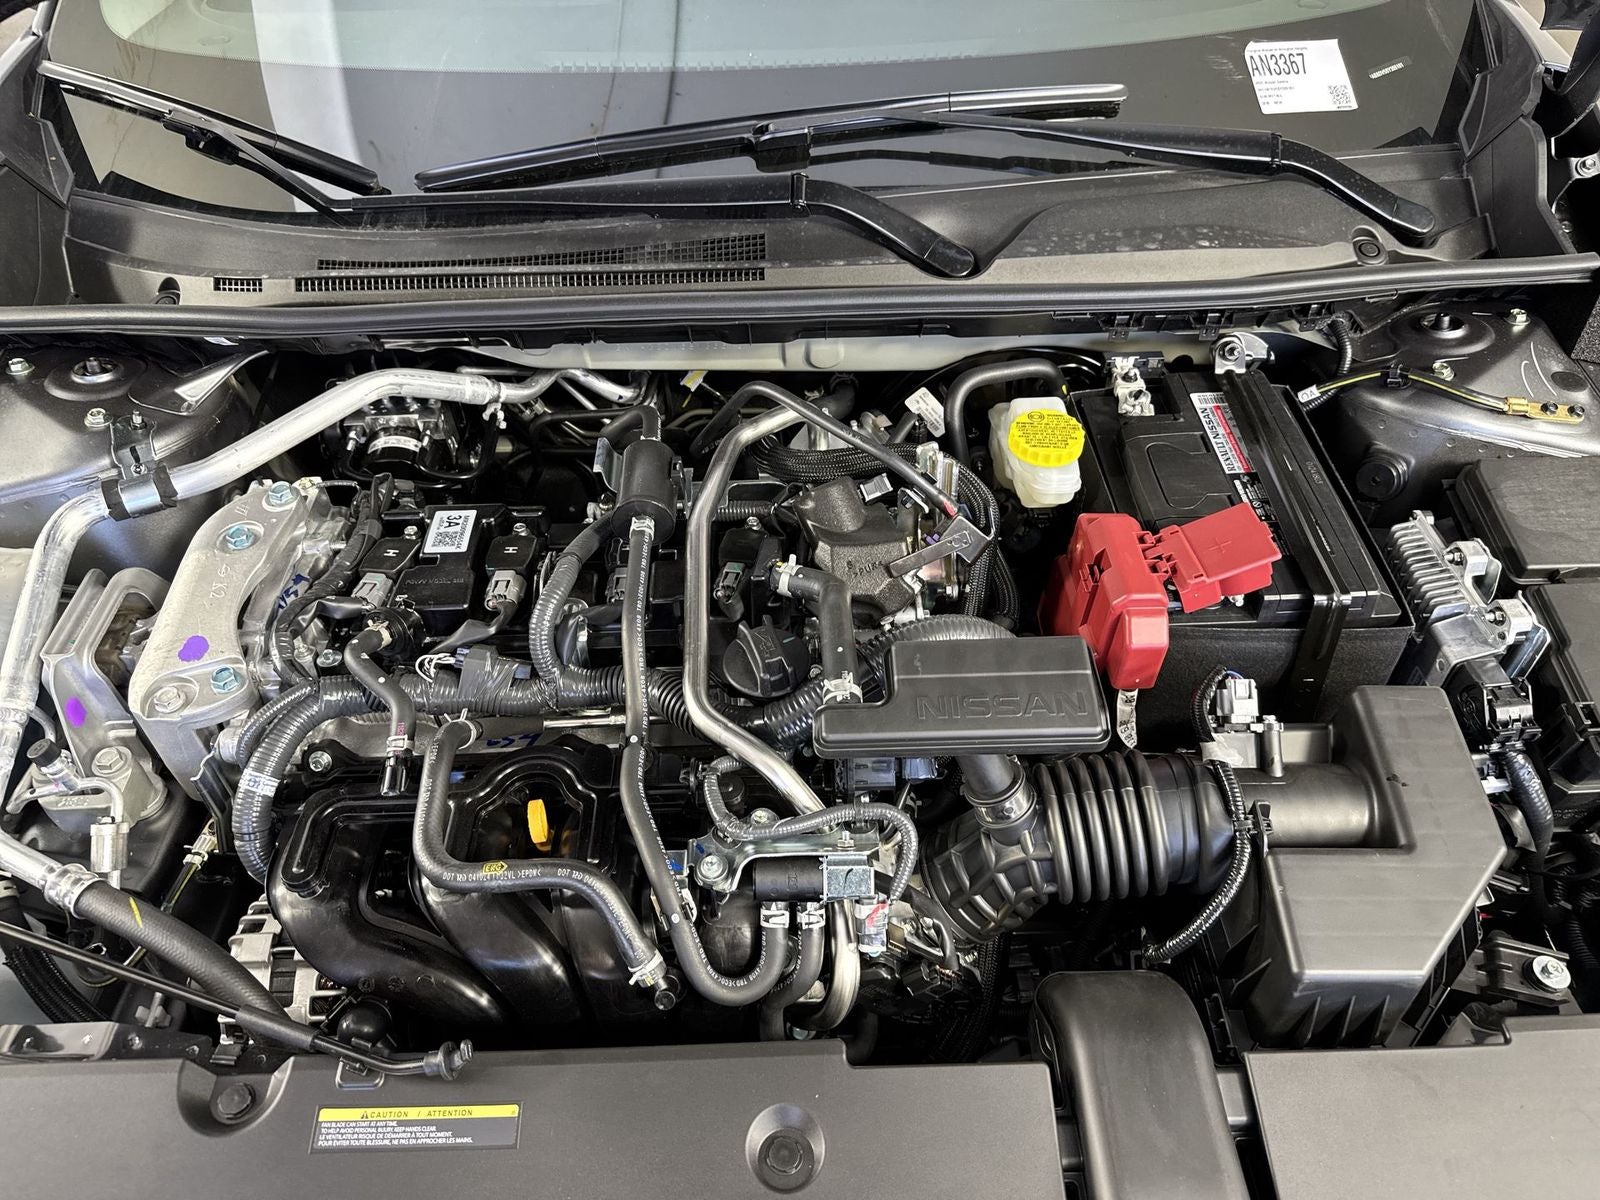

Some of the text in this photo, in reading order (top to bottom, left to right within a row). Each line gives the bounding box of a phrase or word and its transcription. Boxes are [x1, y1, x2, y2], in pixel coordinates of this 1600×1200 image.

[1249, 53, 1307, 77] AN3367
[1200, 407, 1220, 440] NISSAN
[1216, 441, 1236, 472] RENAULT
[444, 515, 462, 528] 3A
[916, 692, 1088, 720] NISSAN
[370, 1110, 409, 1119] CAUTION
[427, 1109, 473, 1117] ATTENTION
